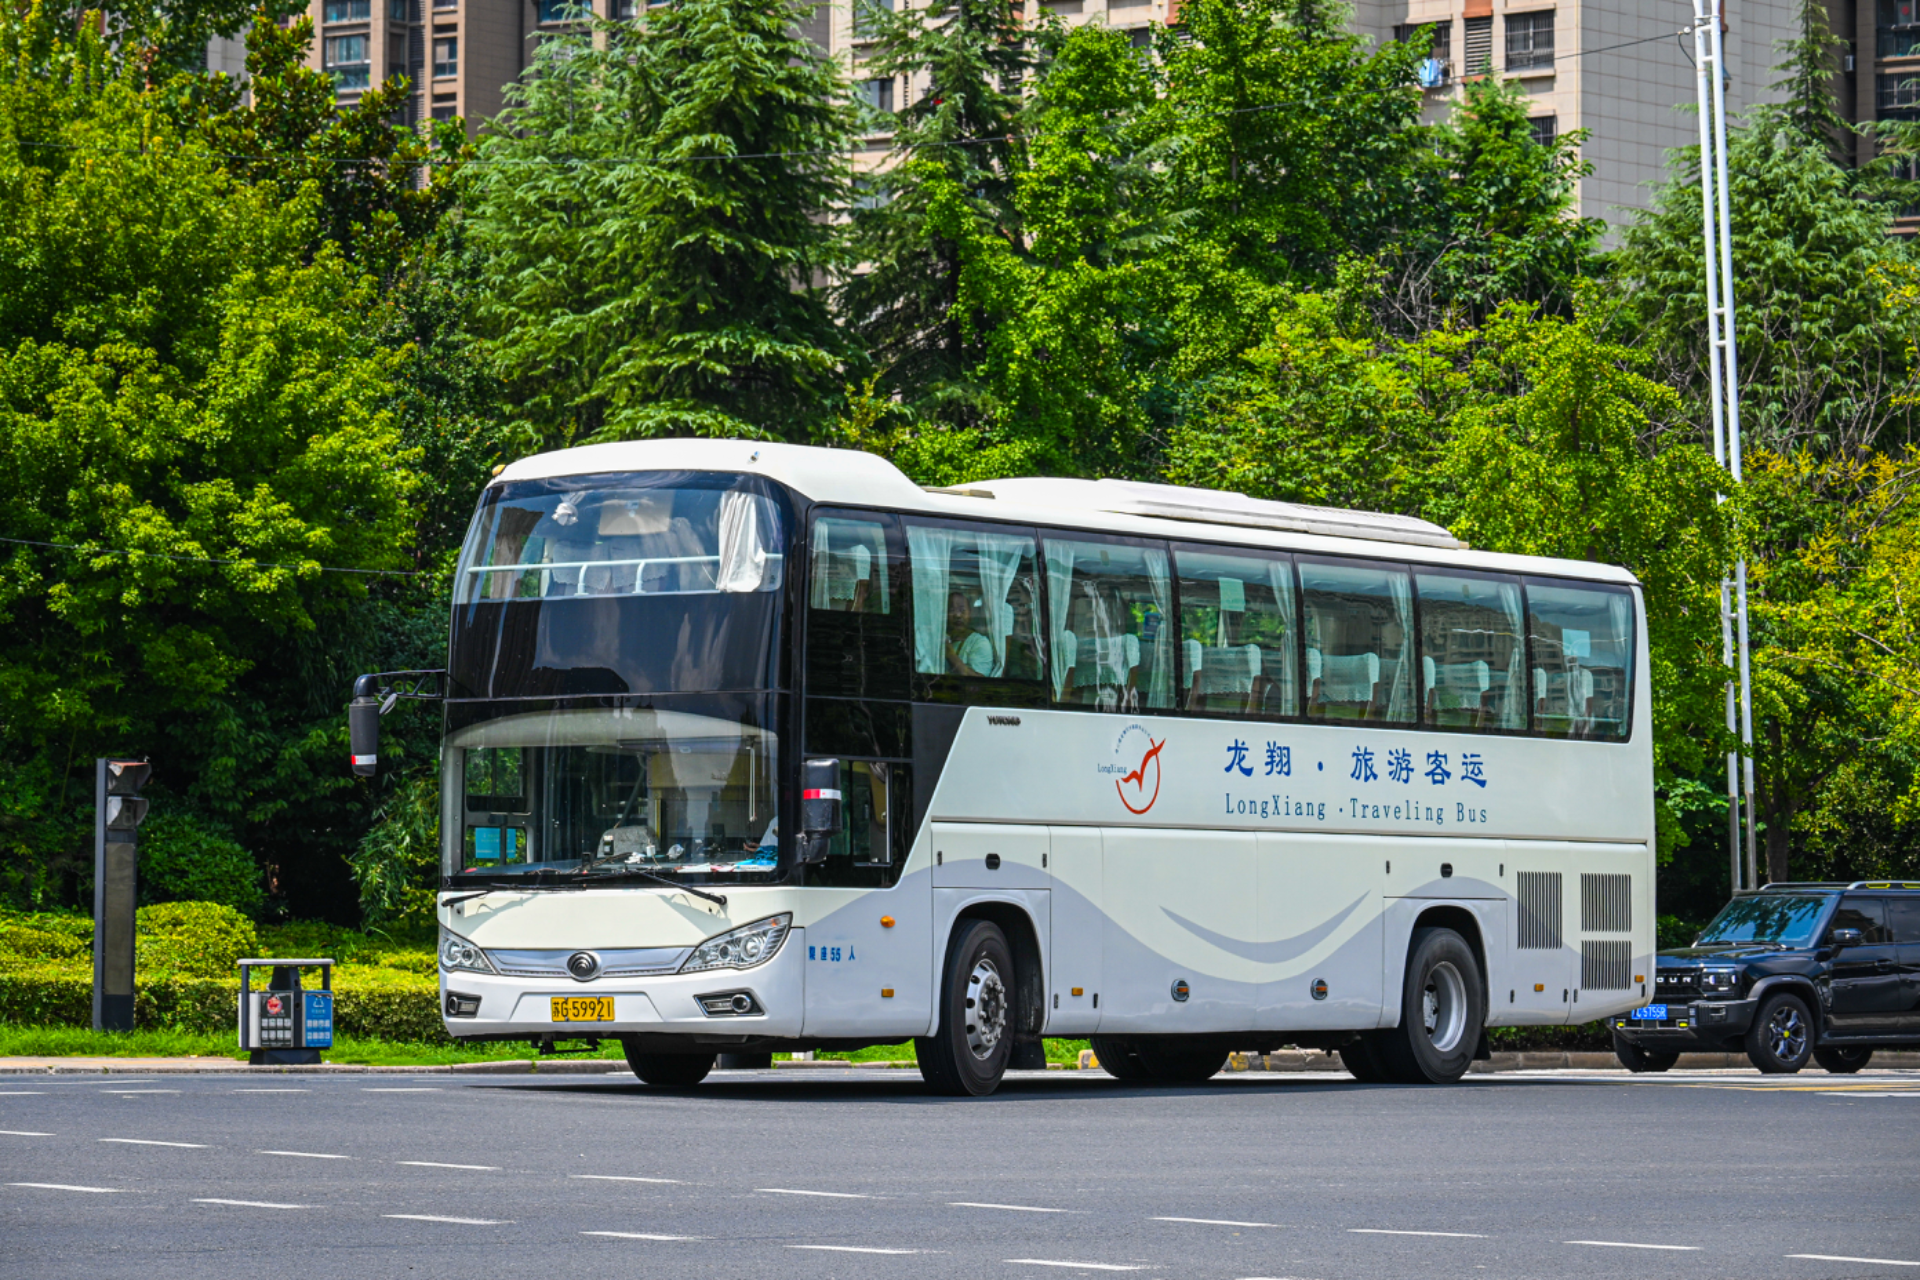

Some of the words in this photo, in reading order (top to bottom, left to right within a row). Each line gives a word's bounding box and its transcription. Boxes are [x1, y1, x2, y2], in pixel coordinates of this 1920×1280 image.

[1225, 793, 1326, 821] LongXiang
[1350, 798, 1444, 825] Traveling
[1456, 802, 1487, 823] Bus
